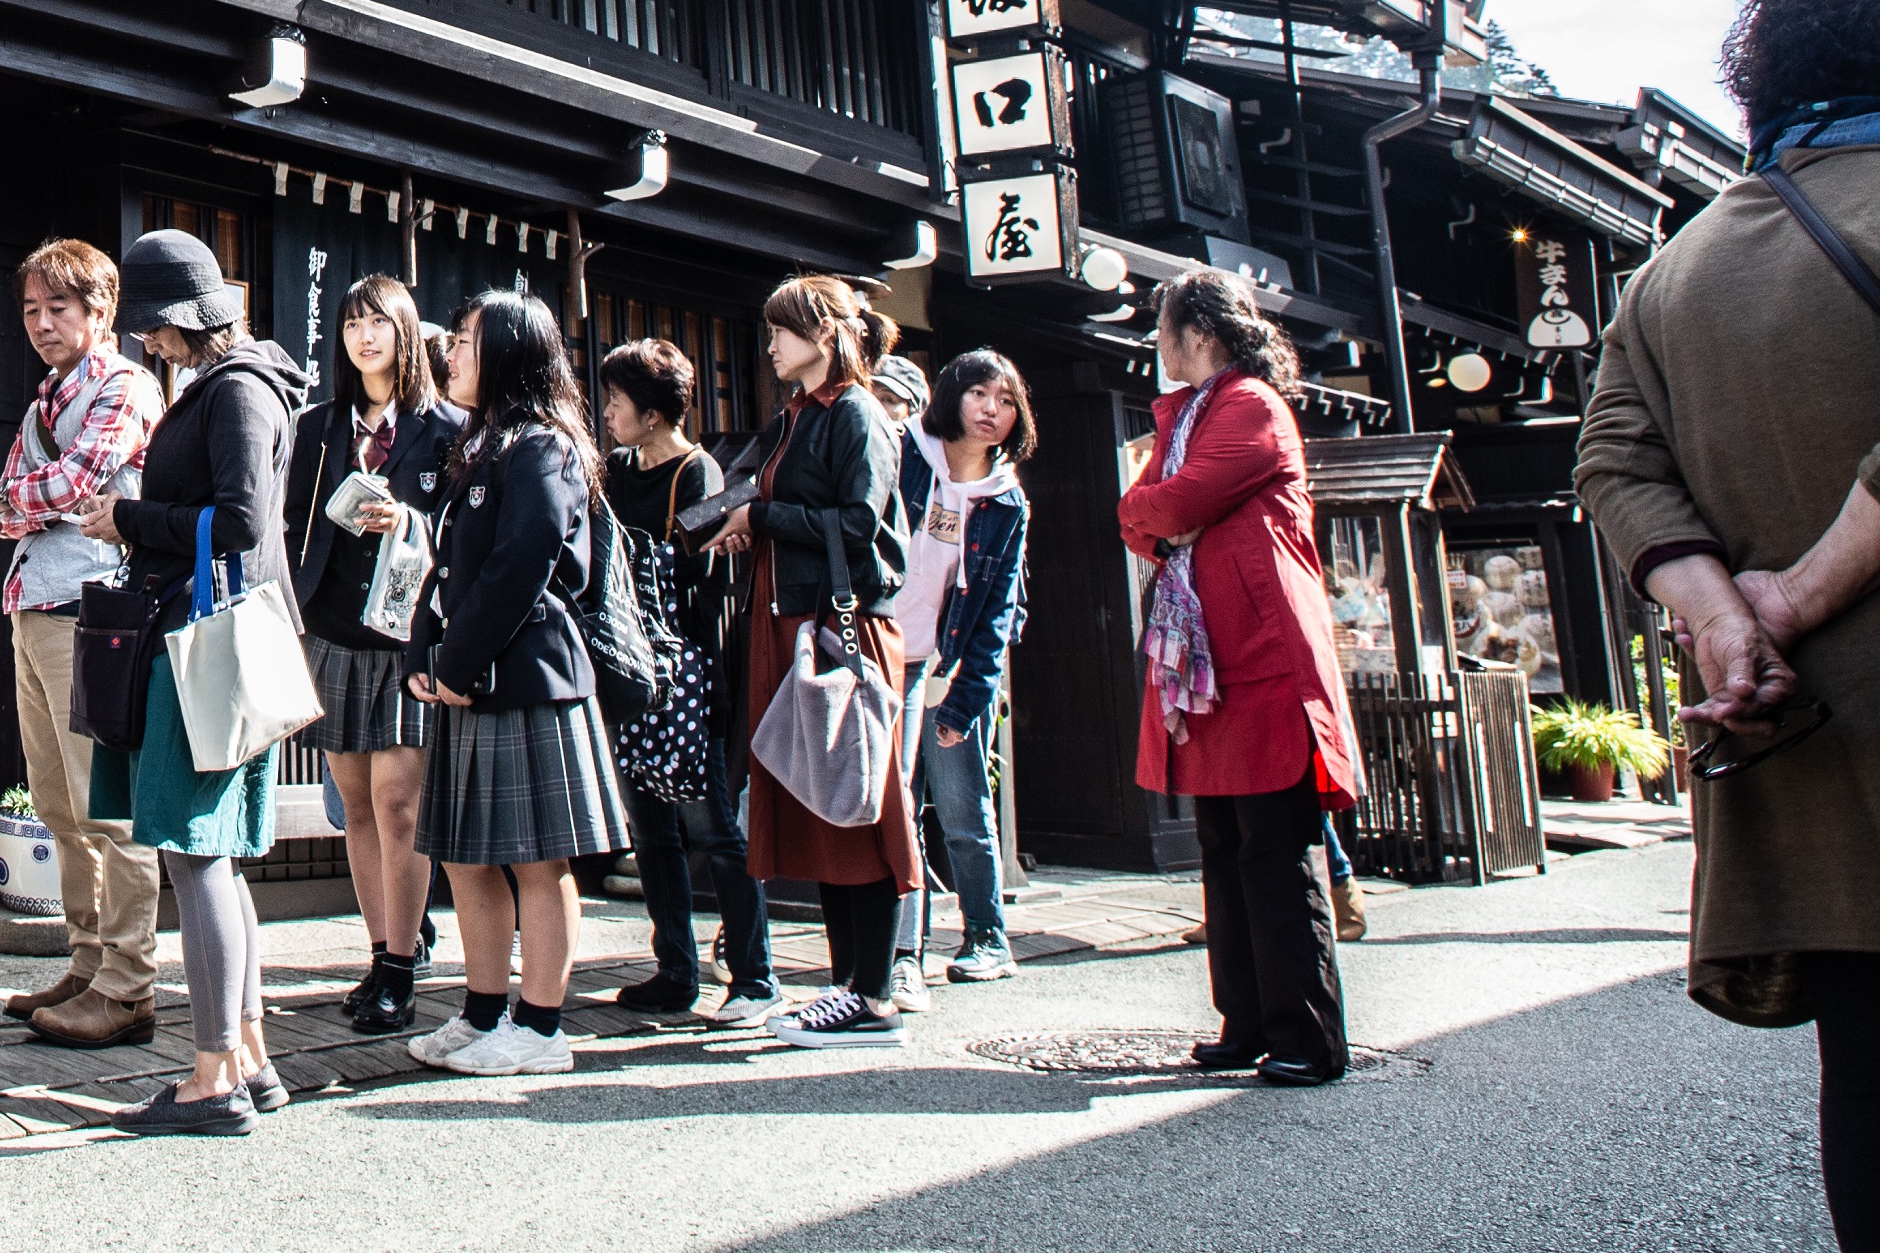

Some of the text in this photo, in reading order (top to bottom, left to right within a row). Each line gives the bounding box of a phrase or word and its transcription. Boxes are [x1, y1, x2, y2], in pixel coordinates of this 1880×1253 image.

[306, 246, 328, 387] 御食事処
[1536, 240, 1568, 307] 牛まん
